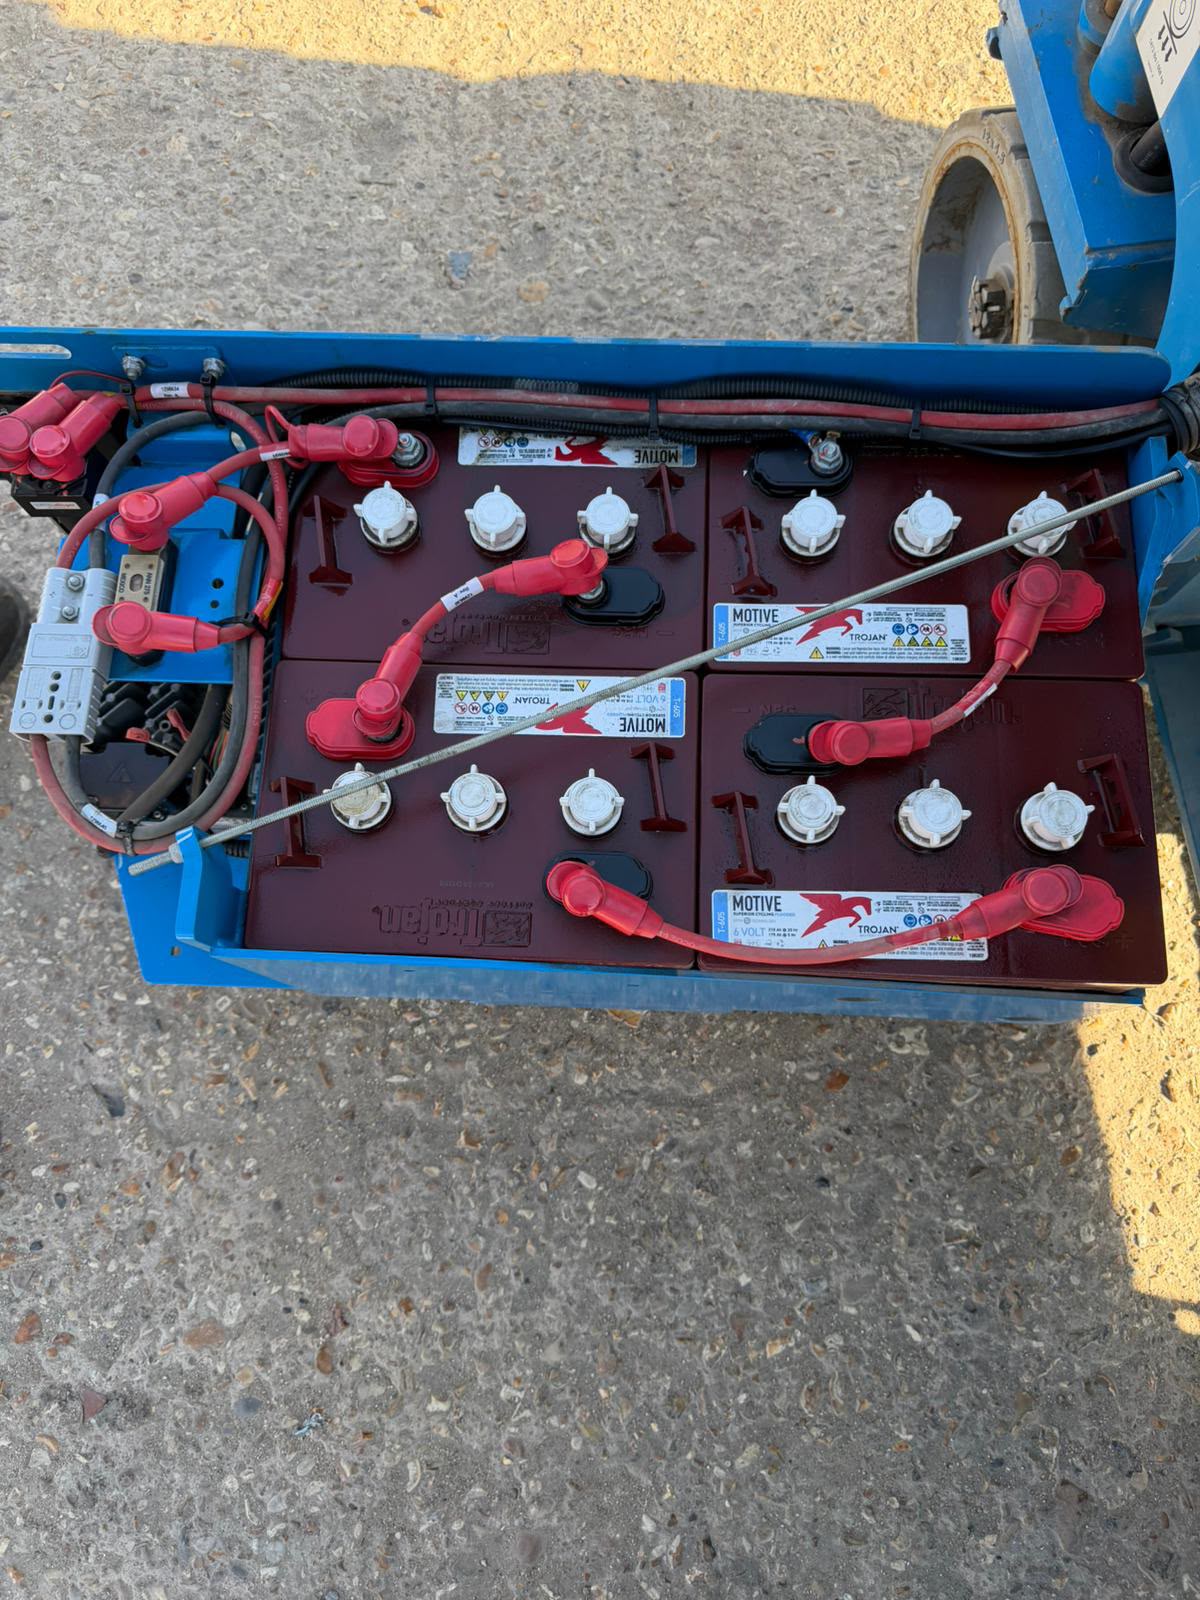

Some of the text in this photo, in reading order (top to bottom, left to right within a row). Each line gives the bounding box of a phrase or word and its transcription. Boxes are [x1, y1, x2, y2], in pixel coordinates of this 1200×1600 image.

[634, 449, 679, 464] MOTIVE
[733, 608, 779, 623] MOTIVE
[850, 633, 886, 641] TROJAN
[515, 696, 550, 704] TROJAN
[636, 695, 659, 703] VOLT
[619, 717, 666, 733] MOTIVE
[732, 895, 782, 912] MOTIVE
[741, 927, 766, 937] VOLT
[858, 925, 898, 934] TROJAN
